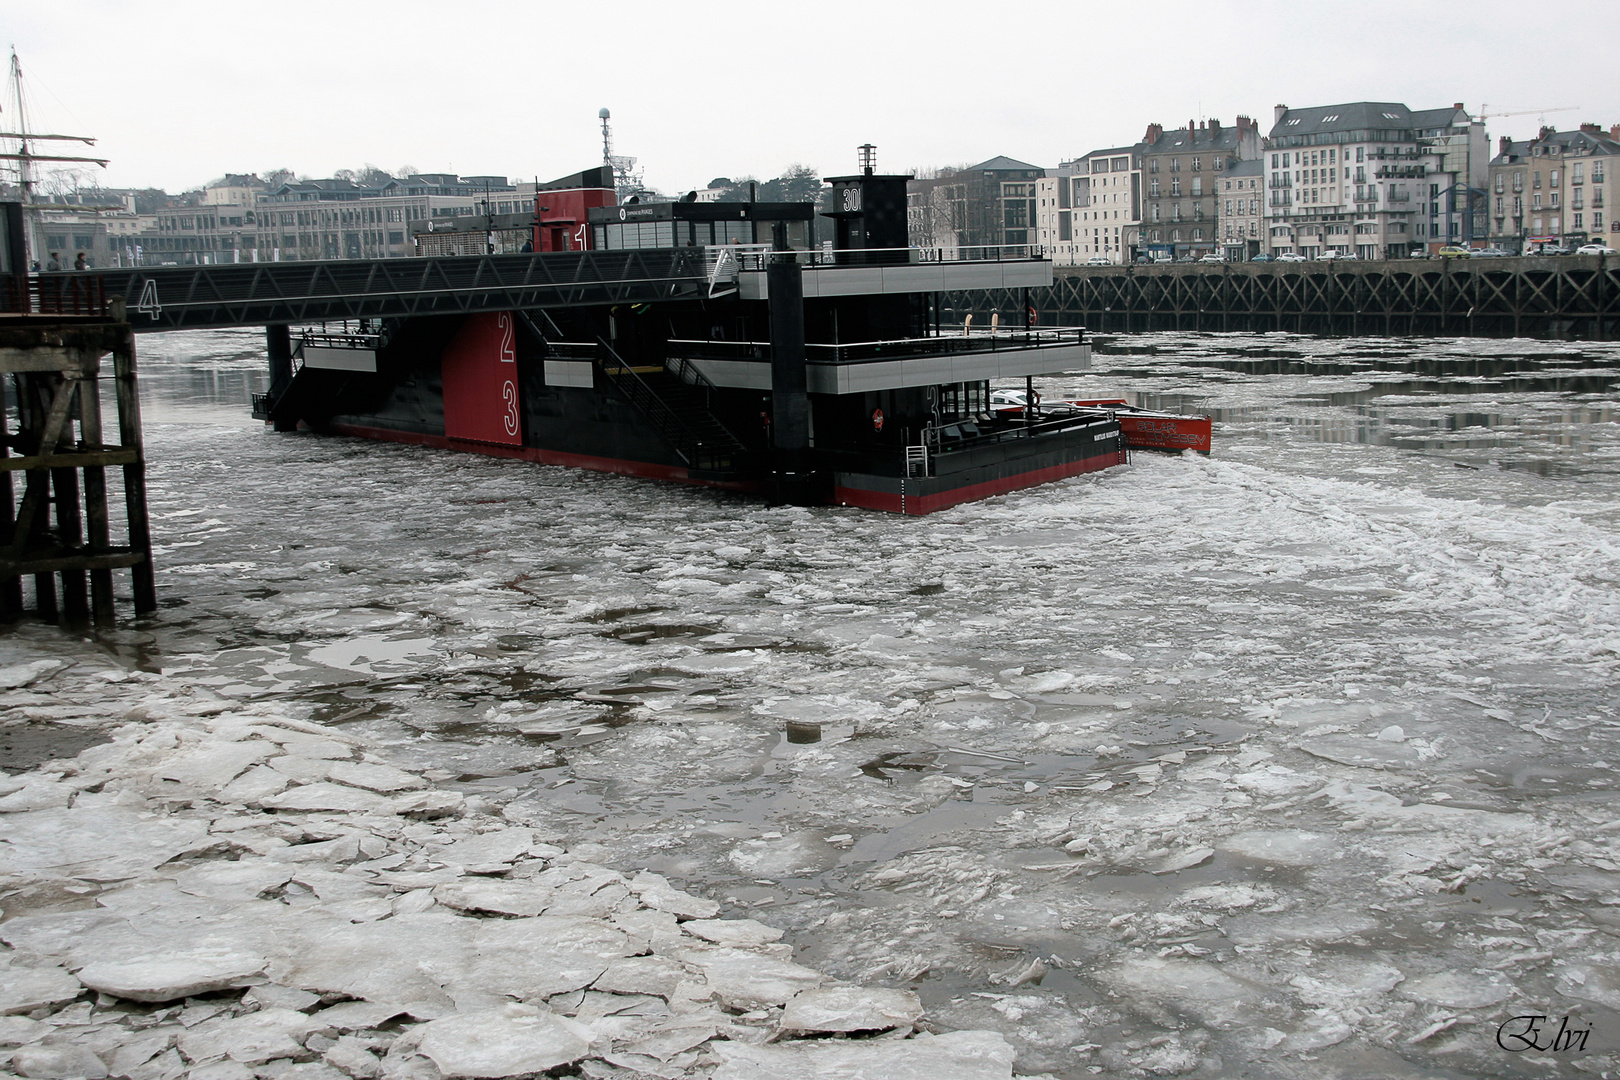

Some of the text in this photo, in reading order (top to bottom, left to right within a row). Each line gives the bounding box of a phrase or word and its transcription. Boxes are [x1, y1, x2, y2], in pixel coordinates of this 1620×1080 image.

[574, 223, 587, 251] 1
[138, 279, 162, 320] 4
[498, 310, 514, 362] 2
[503, 380, 519, 436] 3
[1136, 420, 1177, 434] SOLAR
[1146, 431, 1206, 446] ODYSSEY
